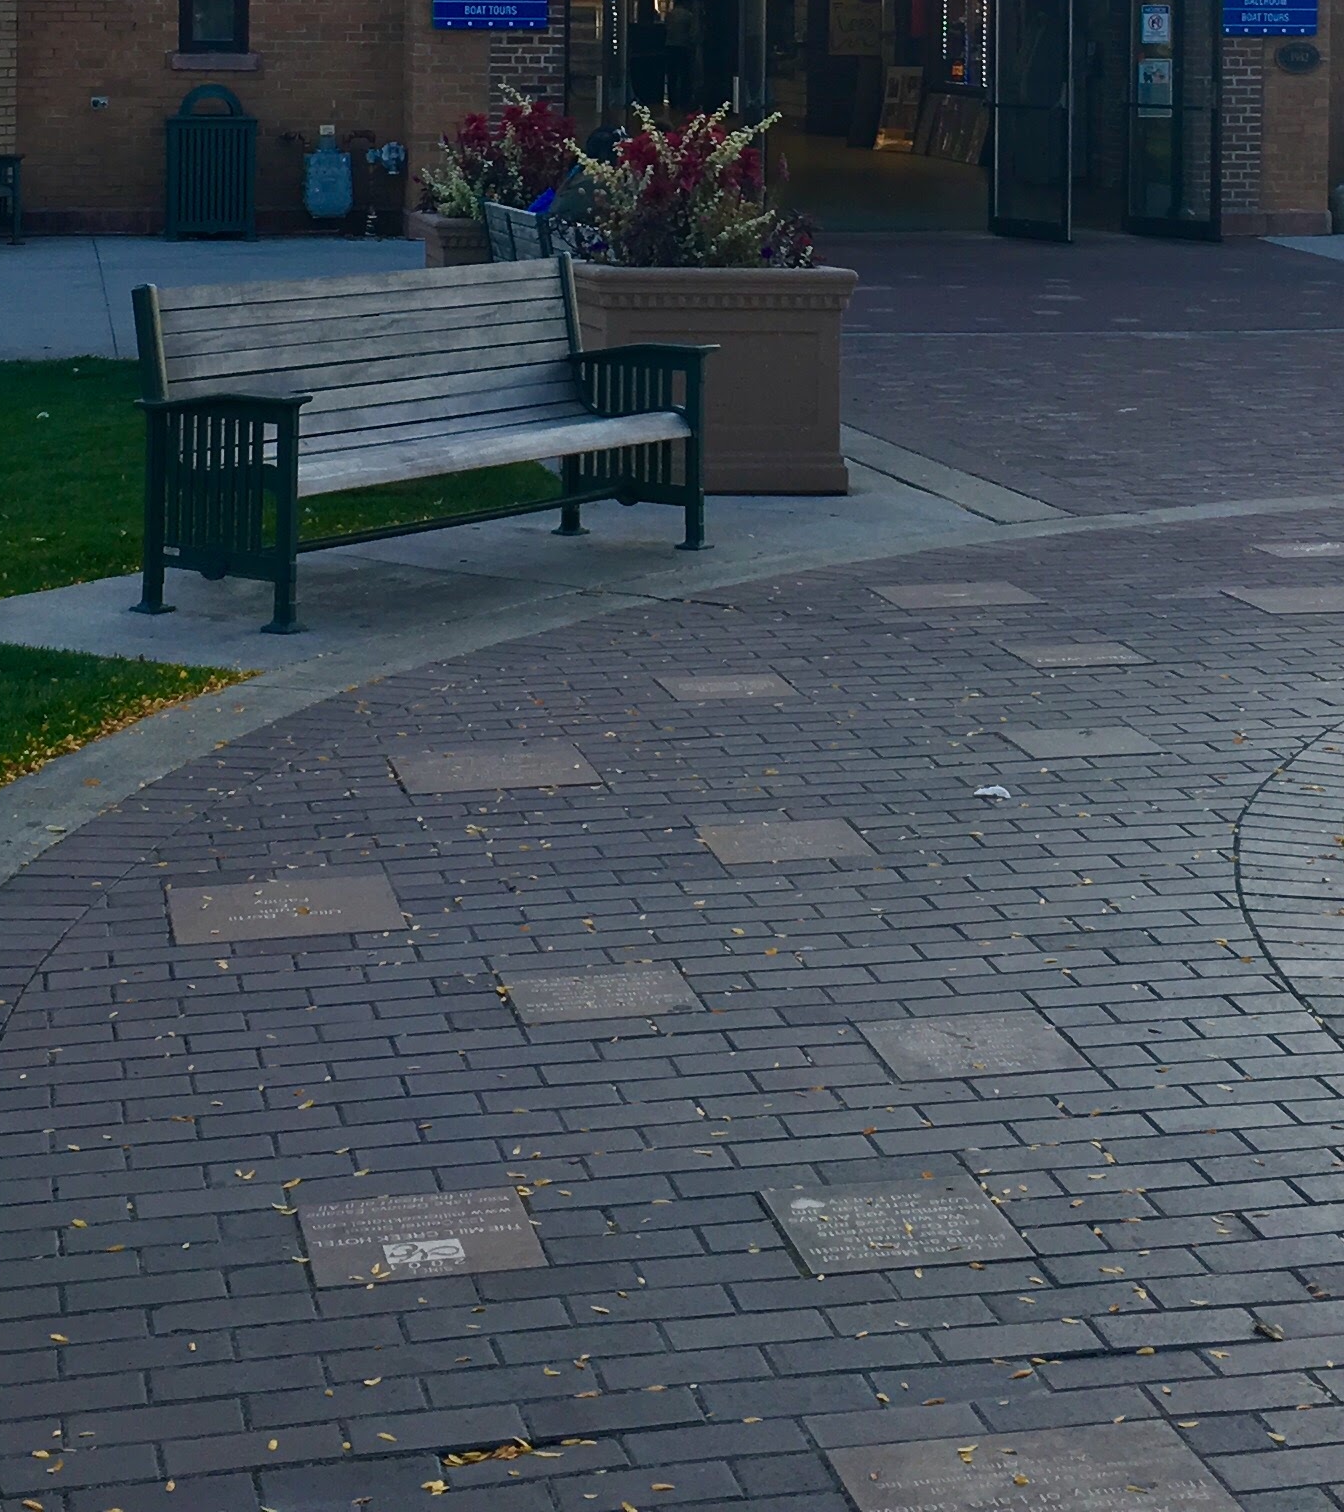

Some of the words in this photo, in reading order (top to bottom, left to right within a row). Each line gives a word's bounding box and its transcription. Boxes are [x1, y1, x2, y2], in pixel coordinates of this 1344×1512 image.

[464, 6, 487, 15] BOAT
[489, 6, 518, 15] TOURS
[1241, 13, 1261, 22] BOAT
[1264, 13, 1289, 22] TOURS
[786, 1213, 851, 1224] Alays
[443, 1226, 484, 1235] MILL
[488, 1223, 521, 1231] THE
[376, 1230, 438, 1241] CREEK
[312, 1236, 371, 1247] HOTEL
[842, 1247, 919, 1260] Memory
